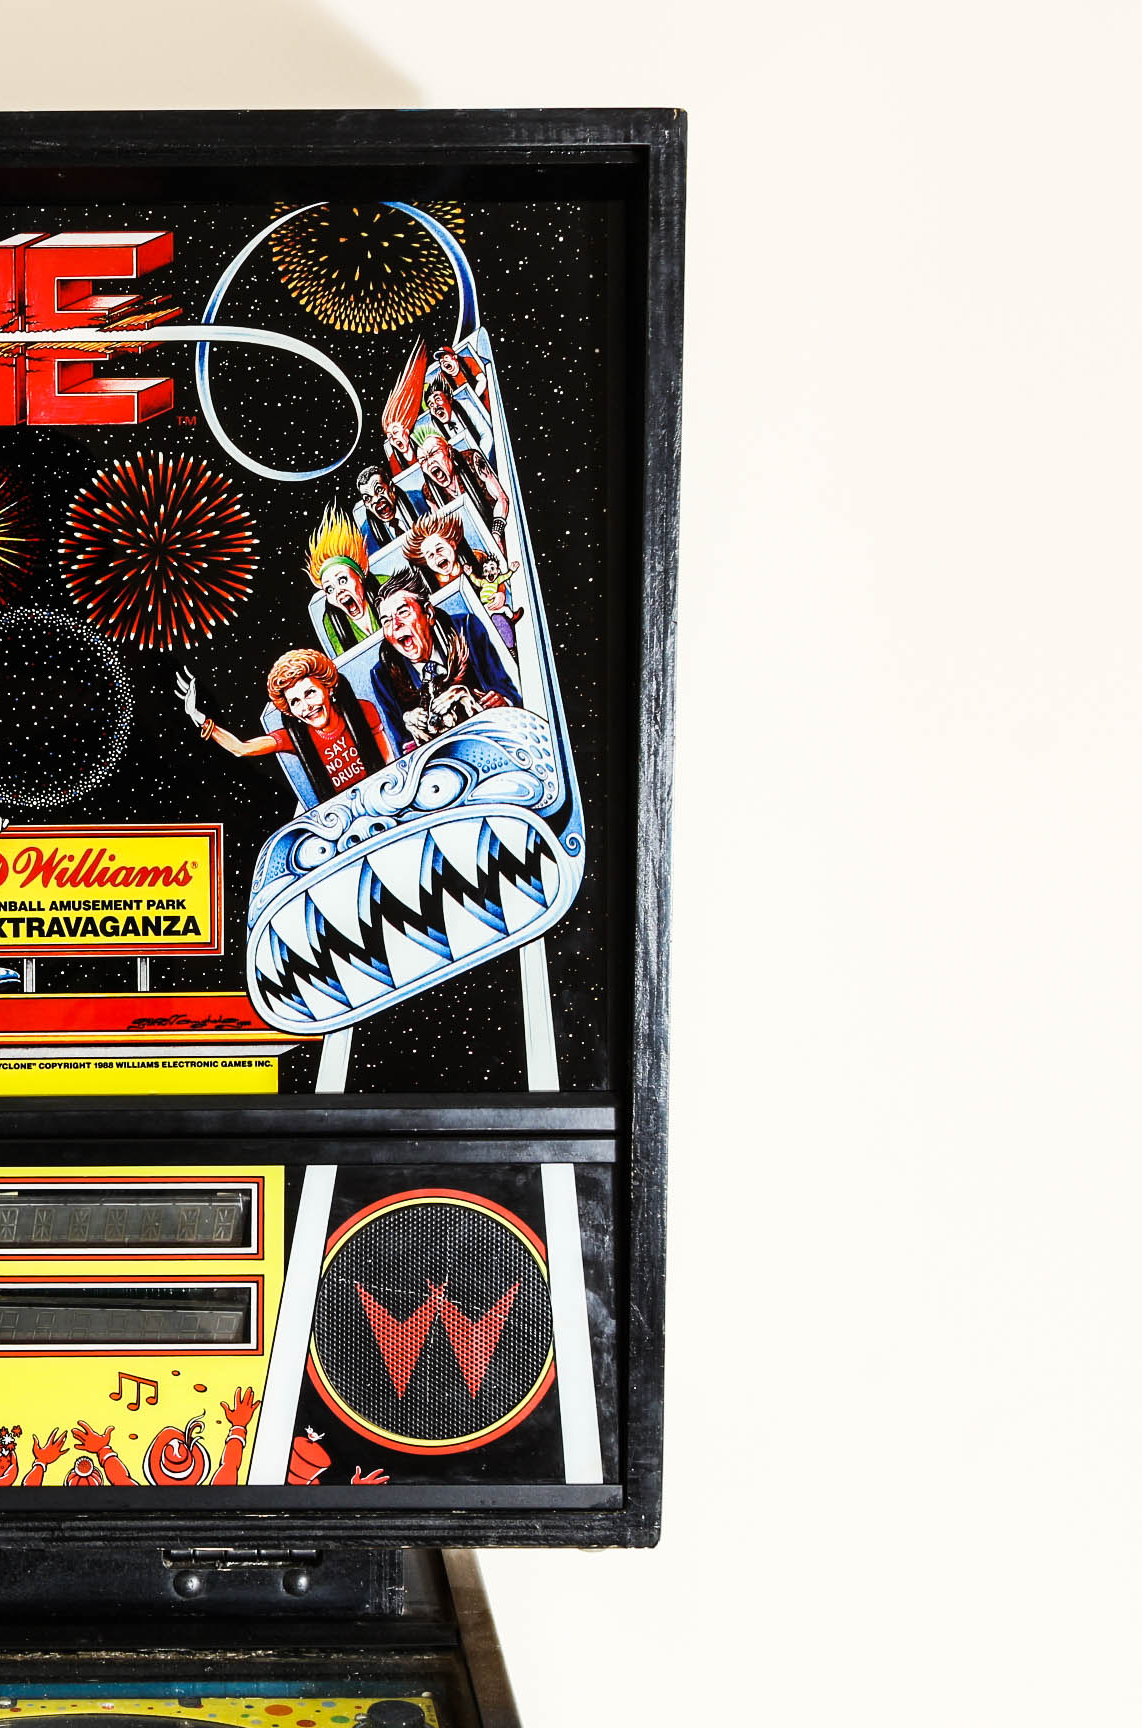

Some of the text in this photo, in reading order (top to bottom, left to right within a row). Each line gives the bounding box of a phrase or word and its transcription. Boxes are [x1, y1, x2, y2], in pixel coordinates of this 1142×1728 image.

[324, 737, 348, 760] SAY
[326, 748, 359, 775] NO TO
[331, 758, 365, 787] DRUGS
[49, 900, 142, 911] AMUSEMENT
[146, 899, 187, 910] PARK
